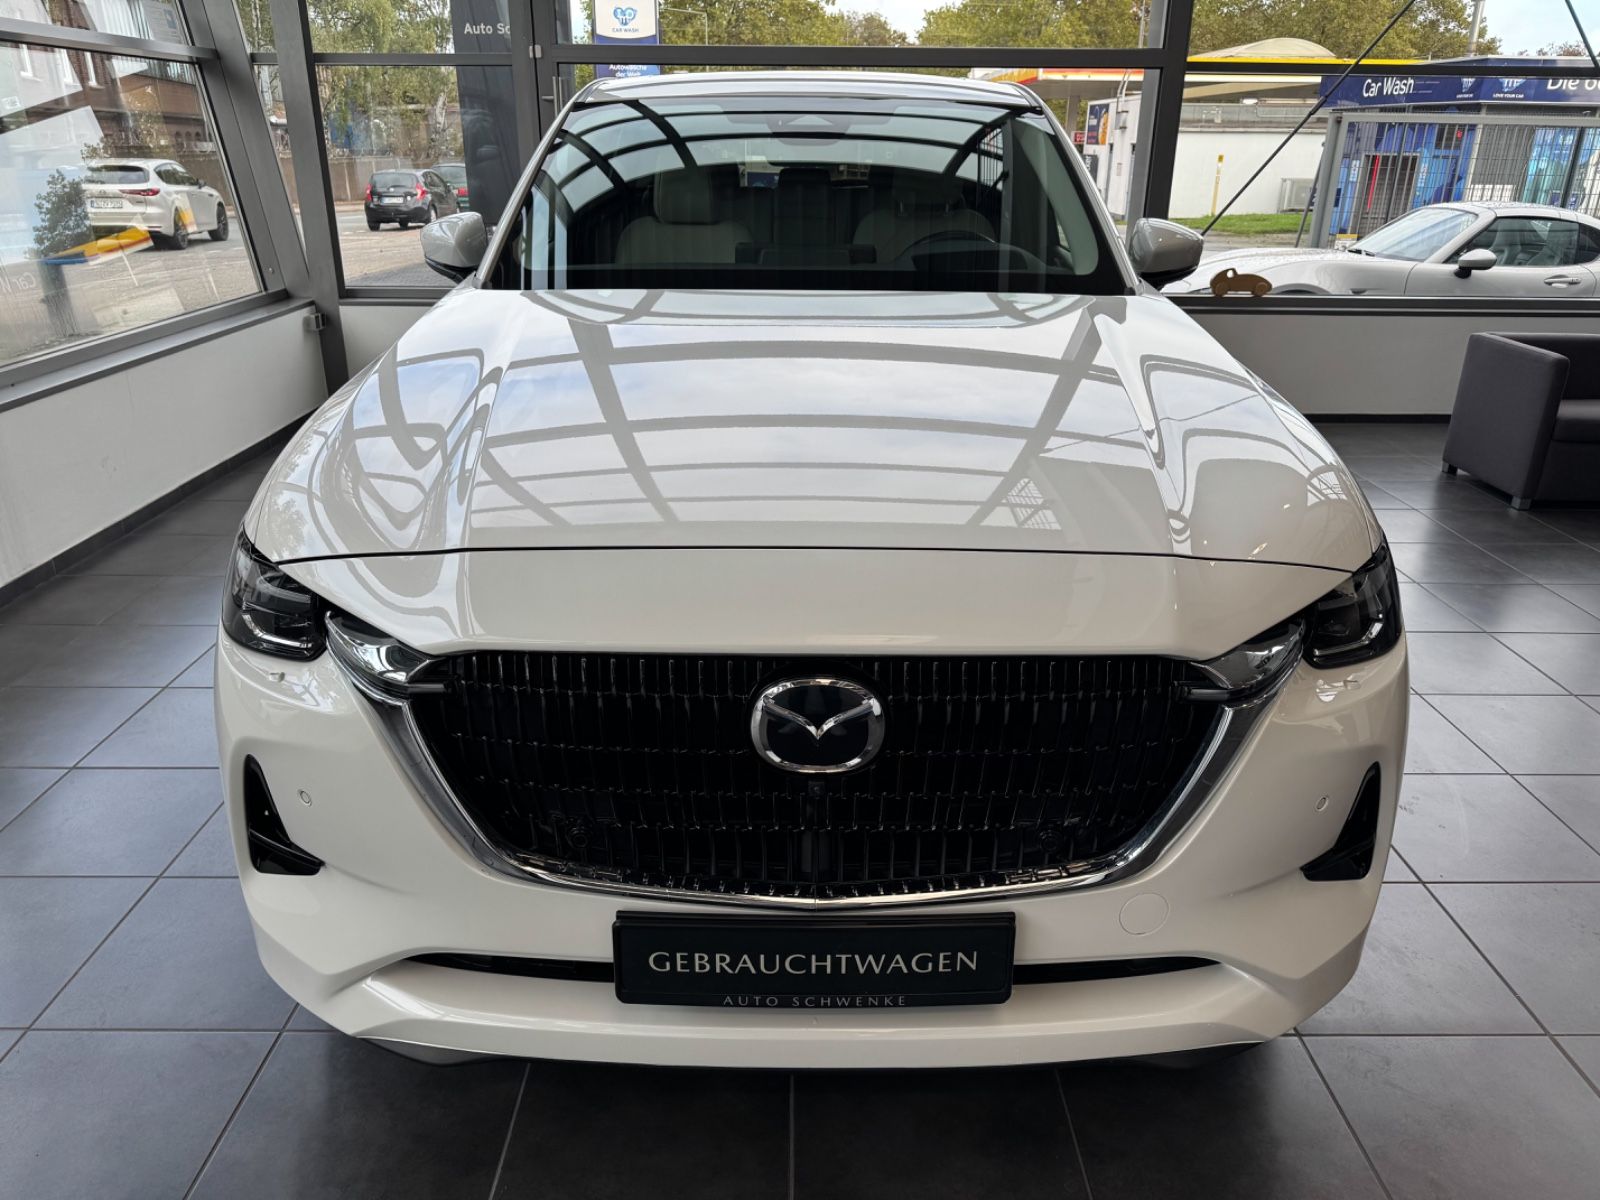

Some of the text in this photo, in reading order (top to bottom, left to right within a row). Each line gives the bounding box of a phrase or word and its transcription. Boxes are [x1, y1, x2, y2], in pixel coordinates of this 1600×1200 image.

[464, 22, 493, 35] Auto
[1362, 76, 1415, 97] Car Wash
[648, 951, 978, 975] GEBRAUCHTWAGEN
[723, 995, 906, 1008] AUTO SCHWENKE
